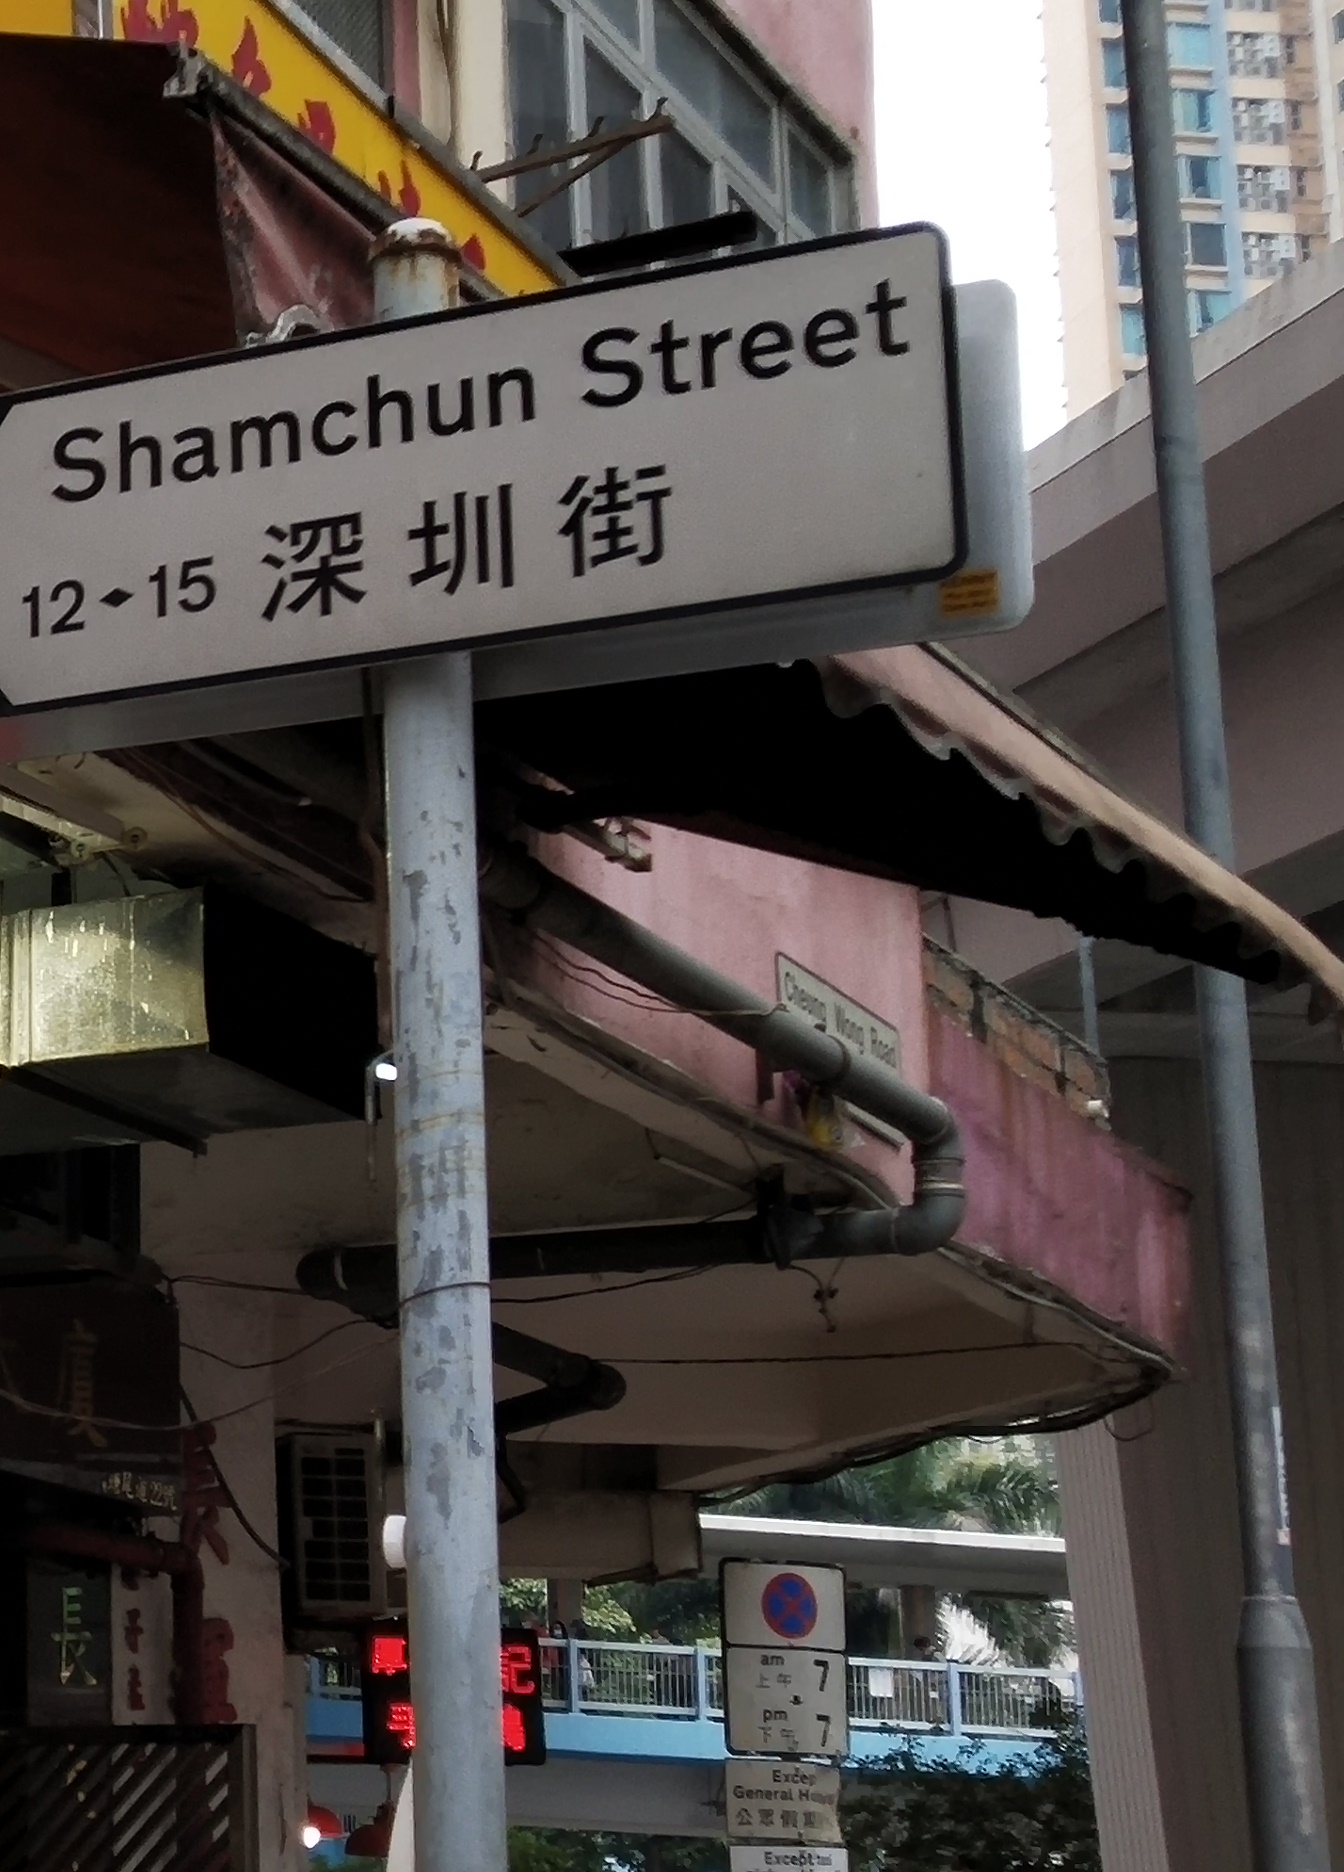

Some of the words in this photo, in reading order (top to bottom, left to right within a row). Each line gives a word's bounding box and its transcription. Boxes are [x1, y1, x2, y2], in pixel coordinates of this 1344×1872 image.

[50, 366, 536, 505] Shamchun
[580, 279, 909, 408] Street
[259, 463, 673, 622] 深圳街
[813, 1658, 830, 1692] 7
[815, 1713, 832, 1747] 7
